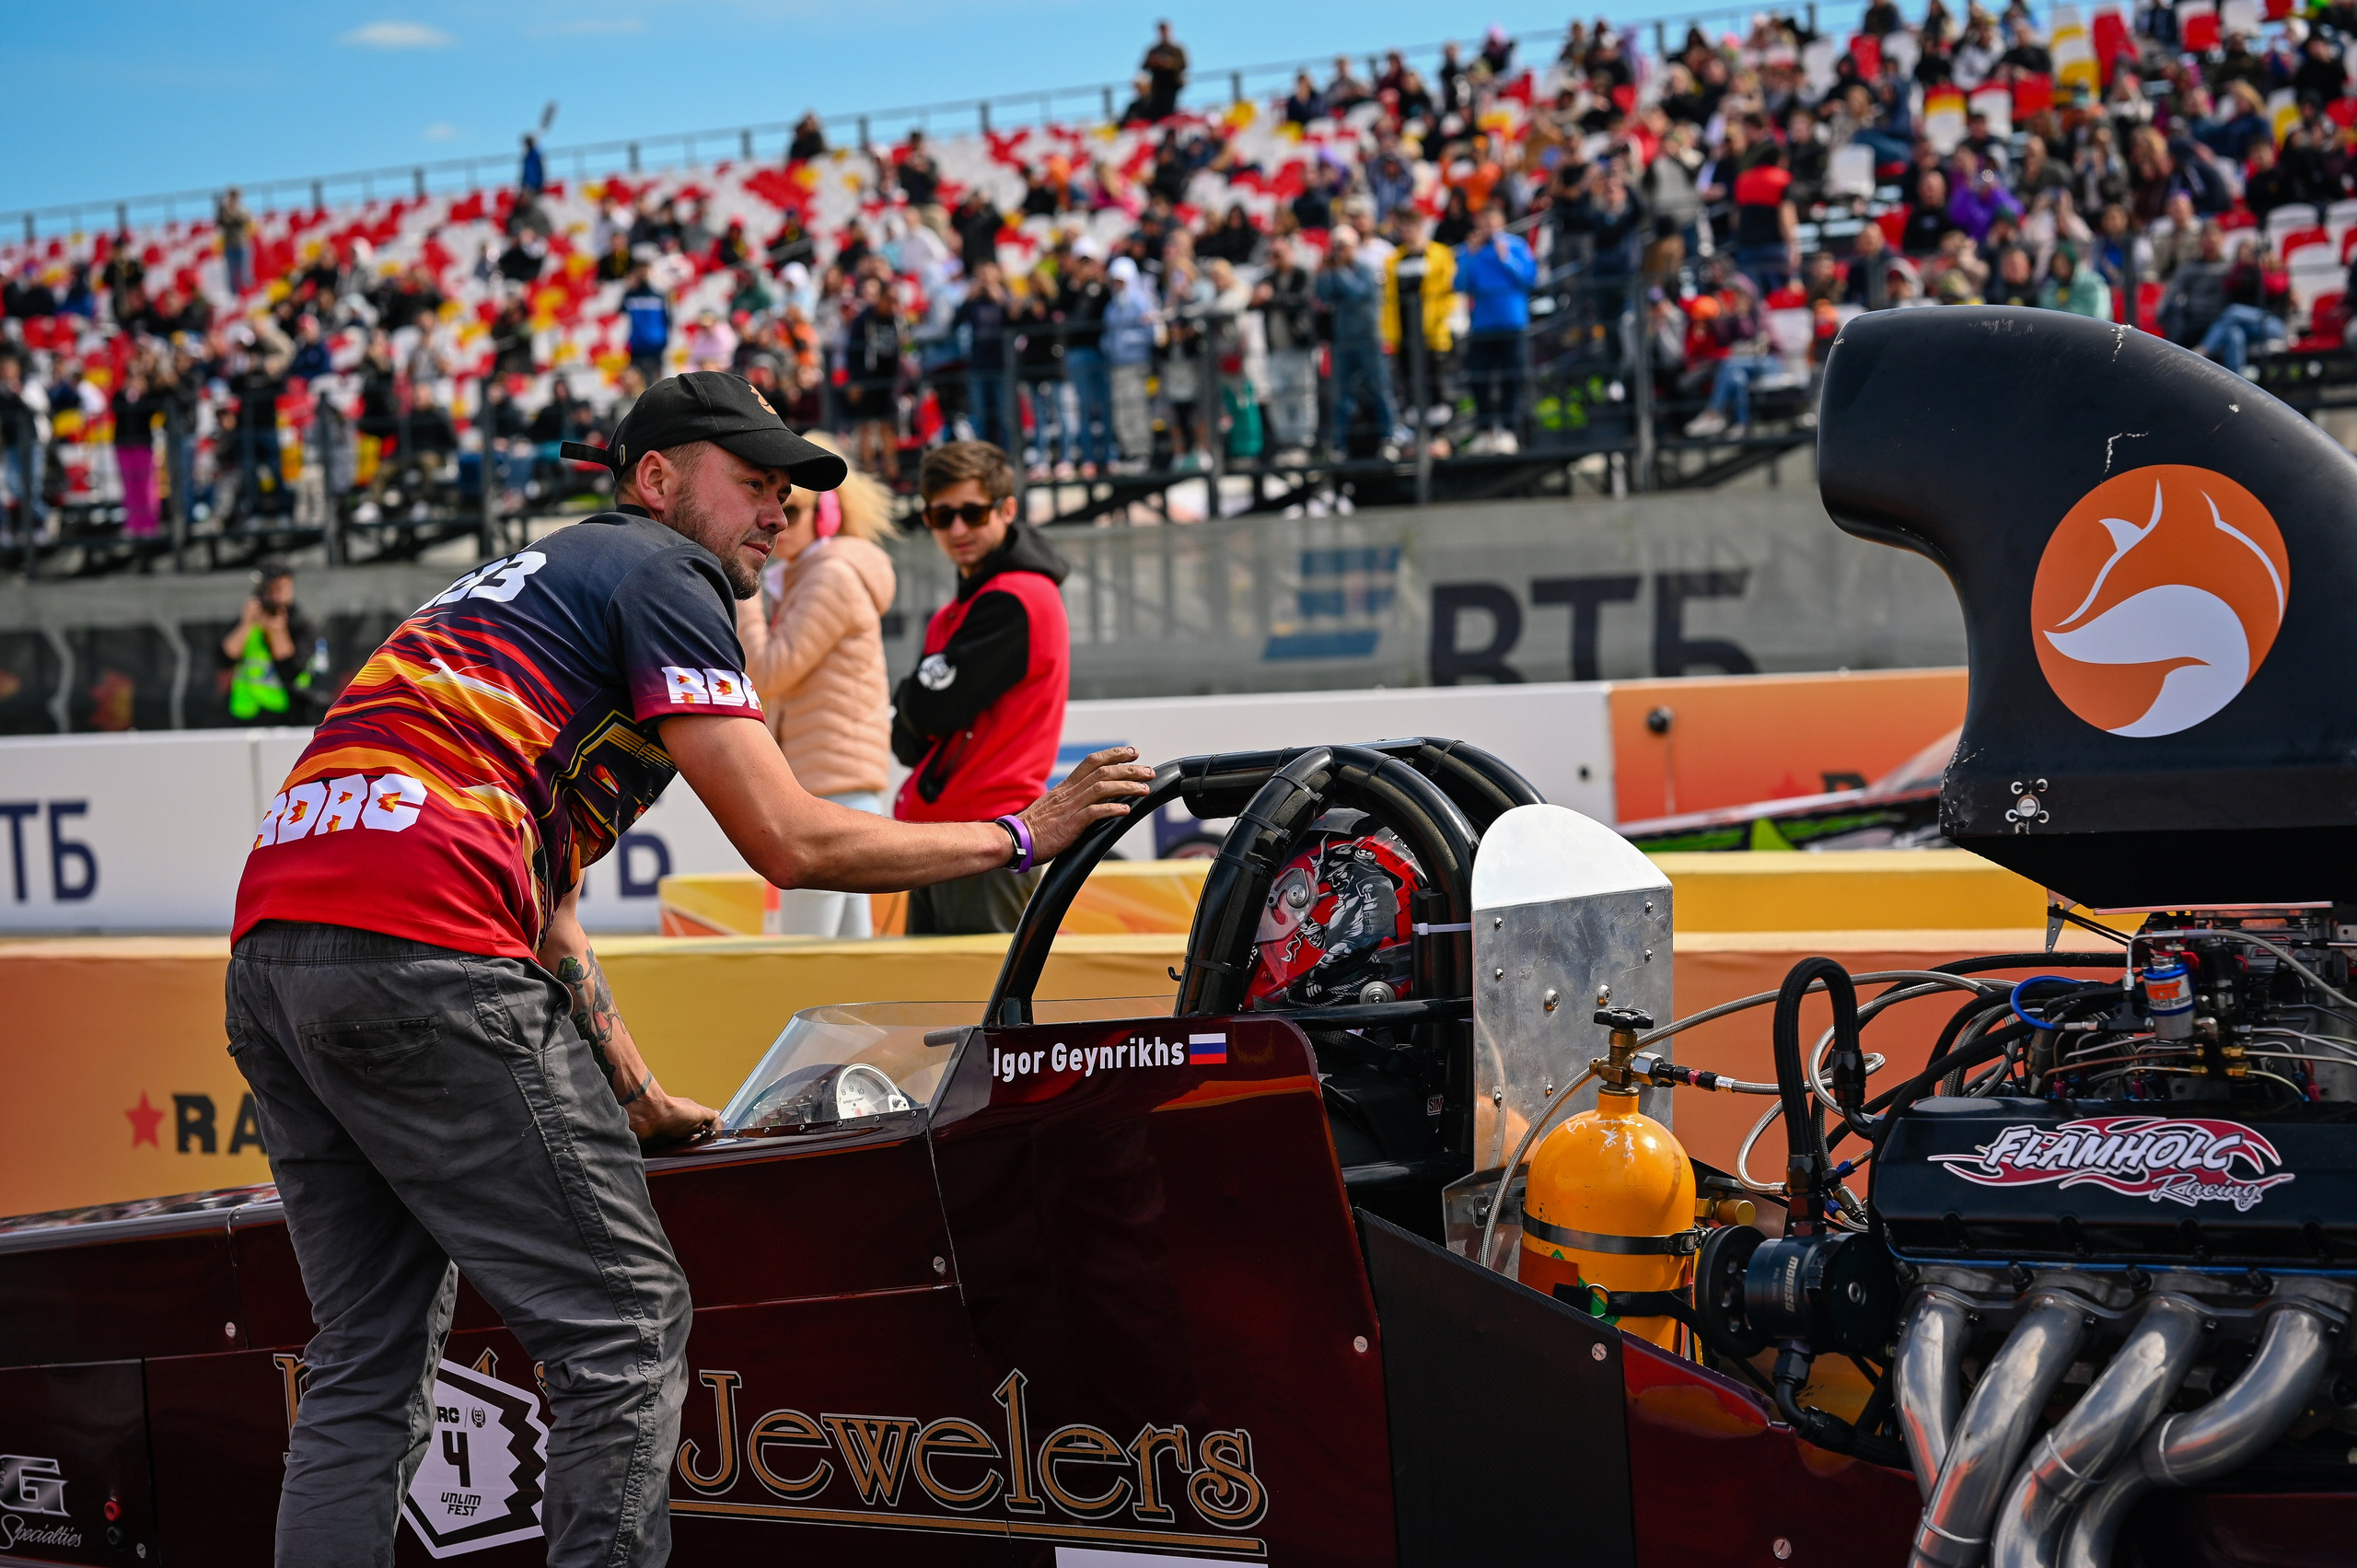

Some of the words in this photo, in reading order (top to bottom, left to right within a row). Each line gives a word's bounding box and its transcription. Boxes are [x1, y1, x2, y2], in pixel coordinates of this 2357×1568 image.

[993, 1047, 1046, 1083] Igor
[1051, 1037, 1185, 1077] Geynrikhs
[856, 1087, 865, 1096] 10
[1983, 1125, 2246, 1172] FLAMHOLC
[2151, 1173, 2264, 1211] Racing
[1784, 1255, 1799, 1313] MOROSO
[441, 1429, 471, 1488] 4
[678, 1368, 1268, 1529] Jewelers
[440, 1493, 482, 1505] UNLIM
[447, 1504, 477, 1516] FEST
[0, 1514, 83, 1550] Specialties
